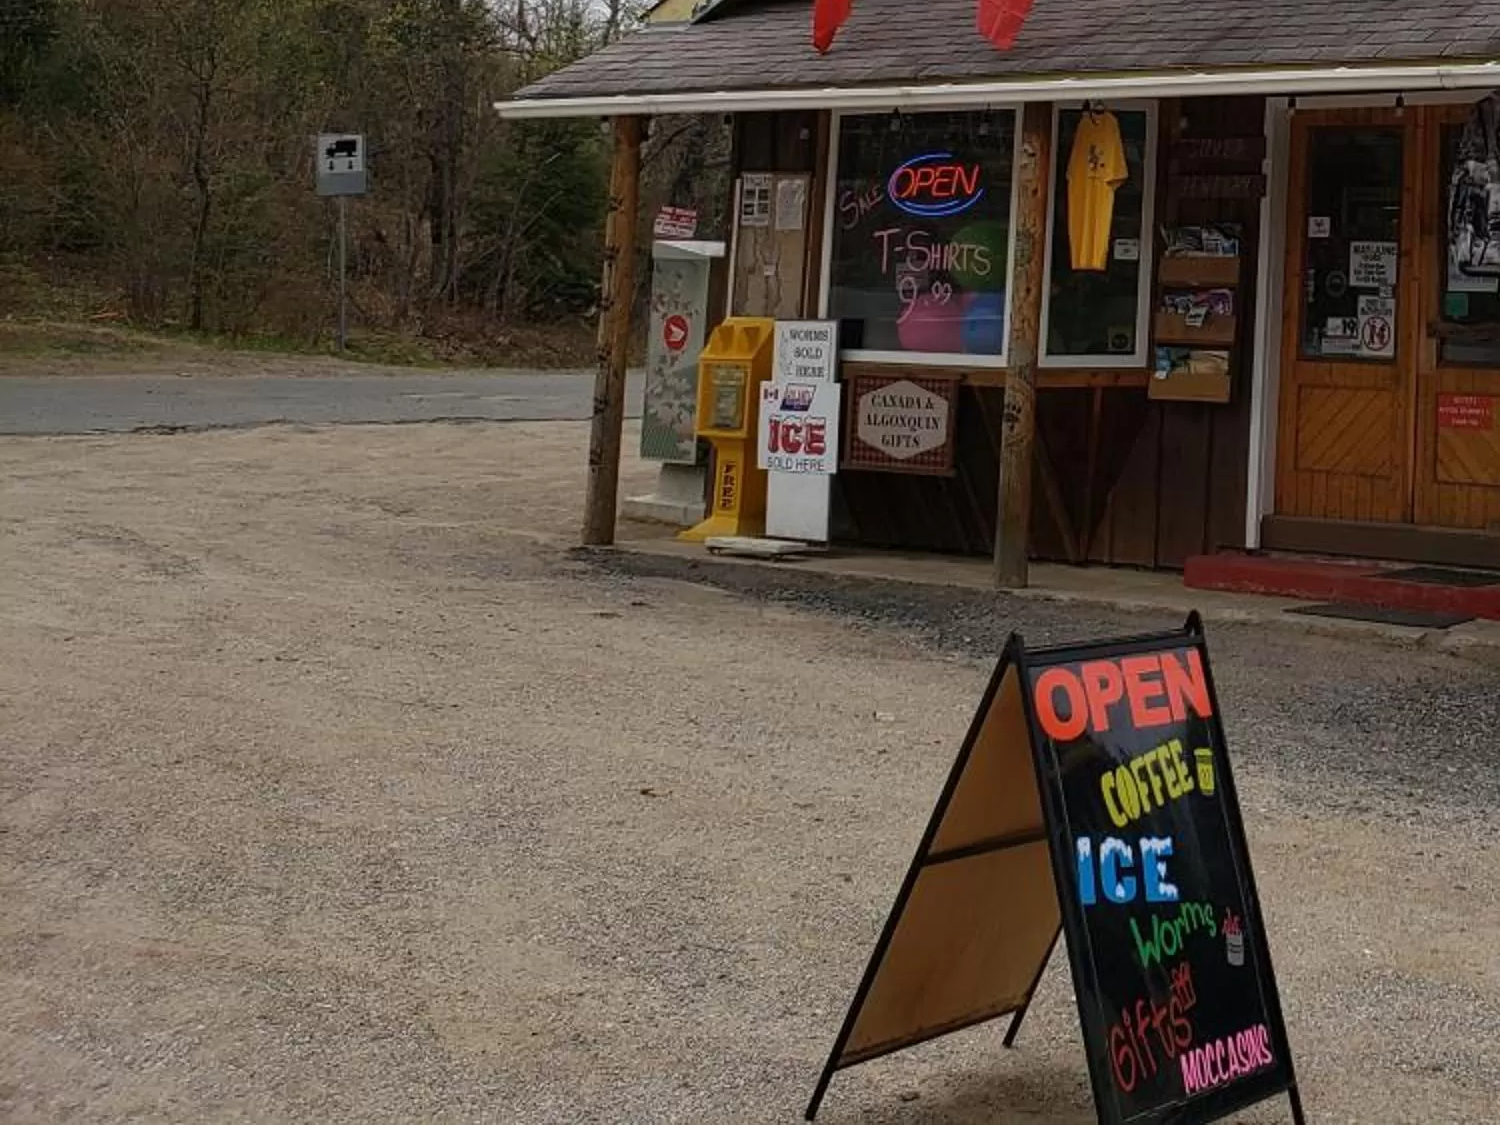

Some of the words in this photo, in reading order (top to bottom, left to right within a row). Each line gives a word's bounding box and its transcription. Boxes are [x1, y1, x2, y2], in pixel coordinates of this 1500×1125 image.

[892, 164, 980, 199] OPEN
[873, 228, 991, 275] T-SHIRTS
[790, 330, 828, 342] WORMS
[794, 346, 823, 359] SOLD
[871, 394, 923, 409] CANADA
[768, 414, 826, 456] ICE
[863, 412, 942, 431] ALGONQUIN
[881, 433, 921, 448] GIFTS
[767, 457, 793, 470] SOLD
[795, 458, 825, 472] HERE
[1034, 647, 1213, 741] OPEN
[1101, 739, 1194, 827] COFFEE
[1076, 836, 1180, 905] ICE
[1180, 1024, 1273, 1094] MOCCASINS
